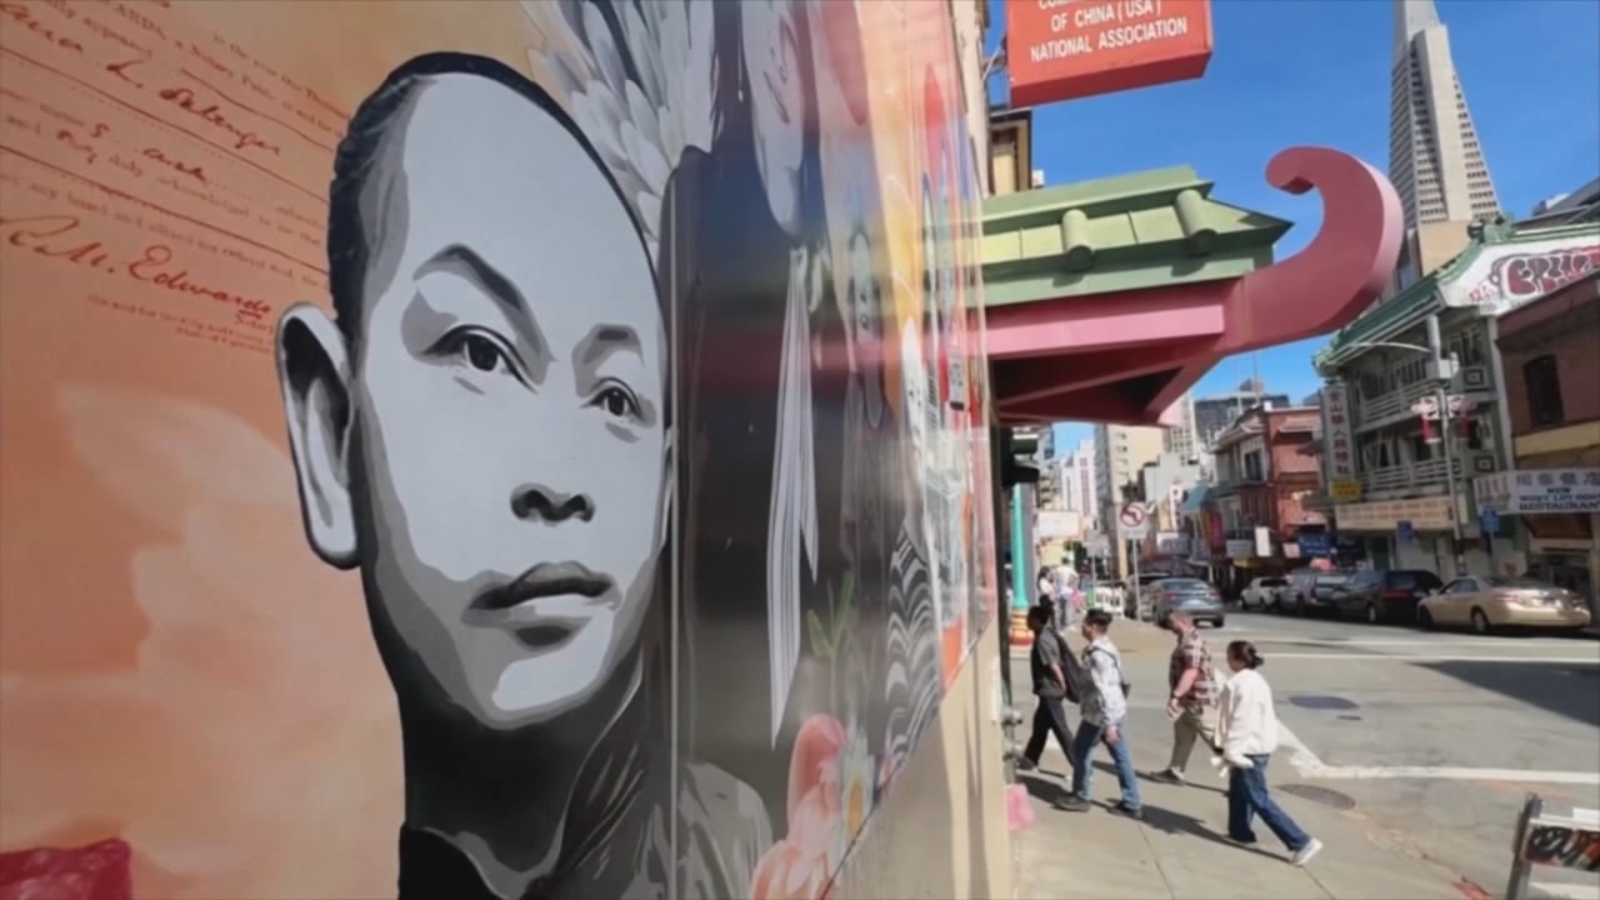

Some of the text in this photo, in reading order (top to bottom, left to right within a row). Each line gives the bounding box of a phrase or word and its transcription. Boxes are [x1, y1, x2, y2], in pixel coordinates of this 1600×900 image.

[1051, 12, 1068, 32] OF
[1074, 4, 1115, 28] CHINA
[1030, 16, 1188, 62] NATIONAL ASSOCIATION
